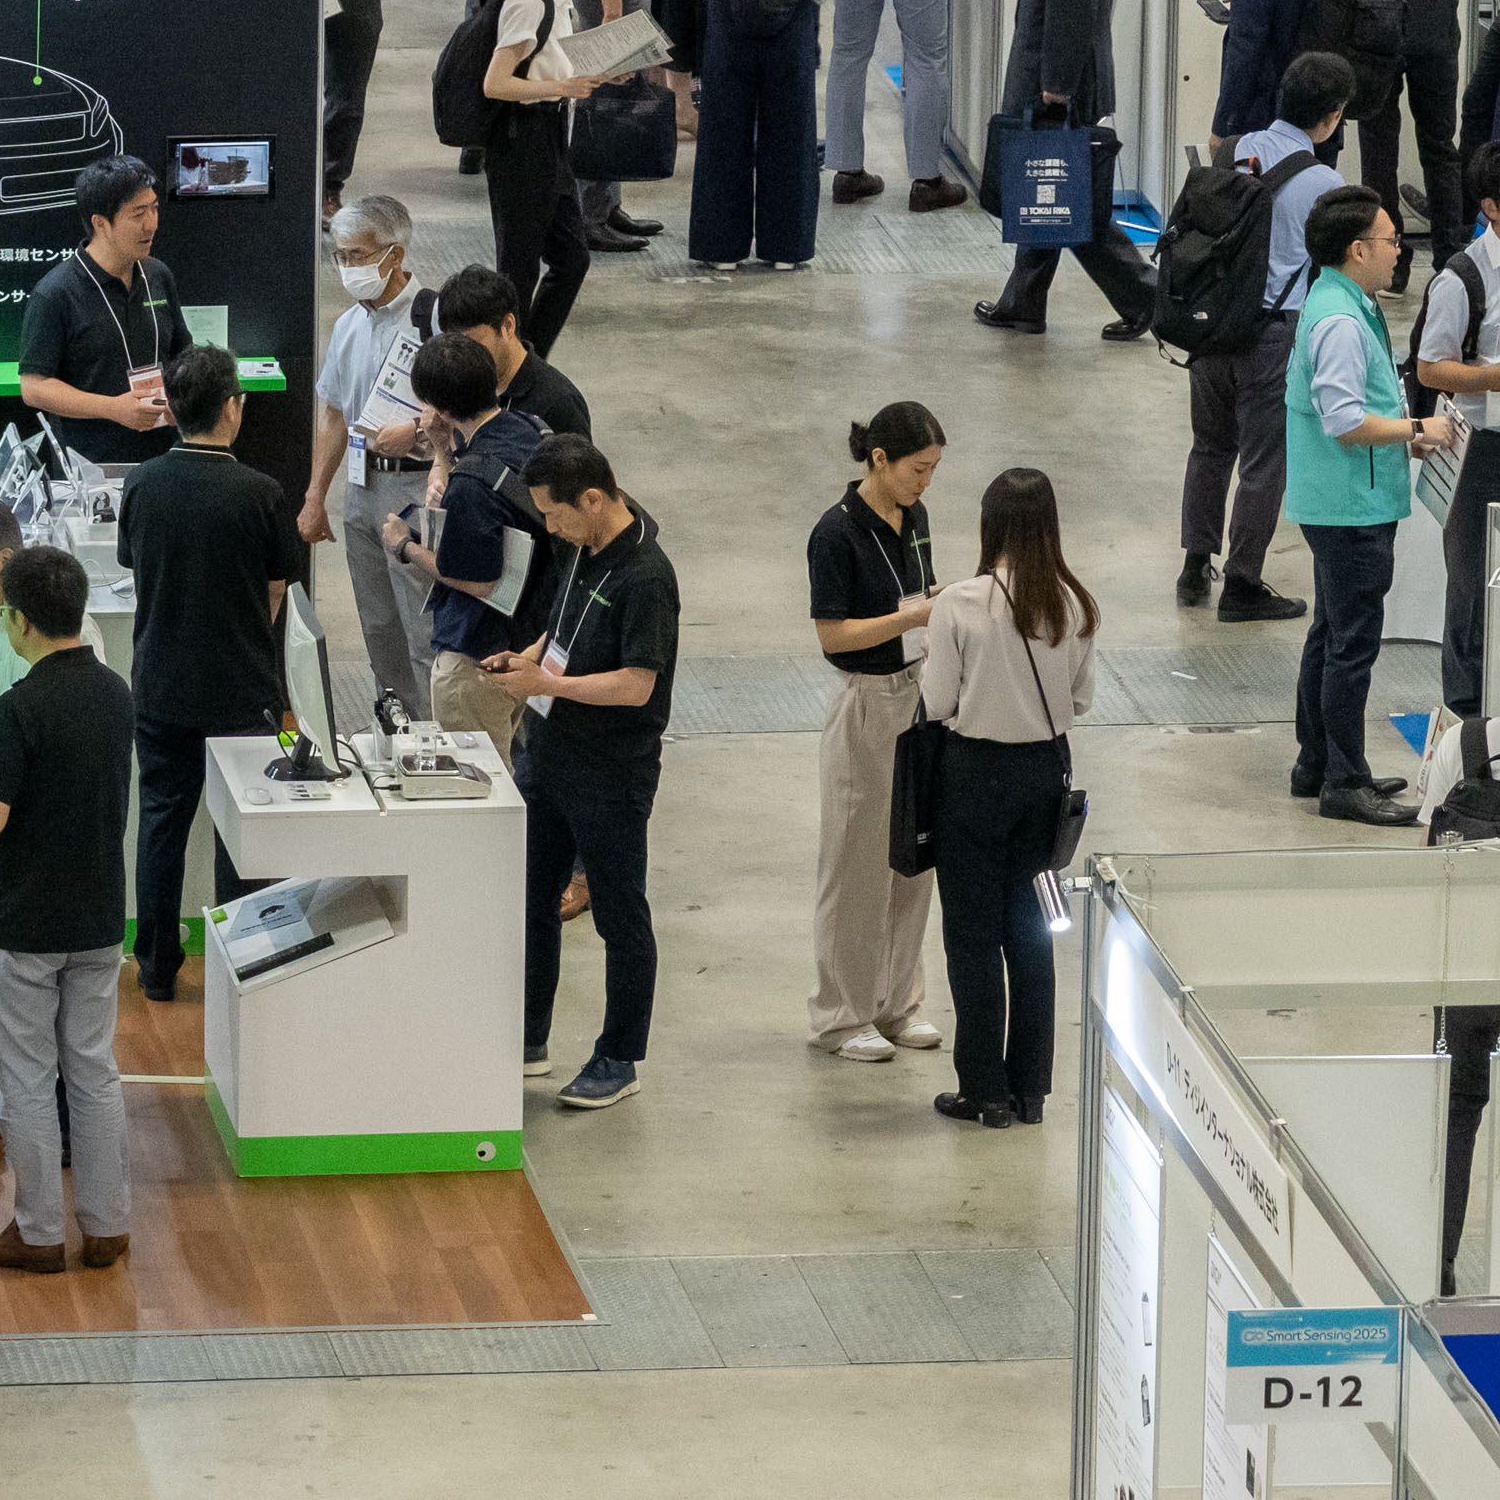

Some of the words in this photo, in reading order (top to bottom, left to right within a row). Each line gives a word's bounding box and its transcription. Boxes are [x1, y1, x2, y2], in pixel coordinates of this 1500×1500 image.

[1167, 1041, 1180, 1087] D-11
[1267, 1326, 1300, 1342] Smart
[1303, 1326, 1350, 1343] Sensing
[1353, 1326, 1386, 1340] 2025
[1263, 1376, 1363, 1409] D-12
